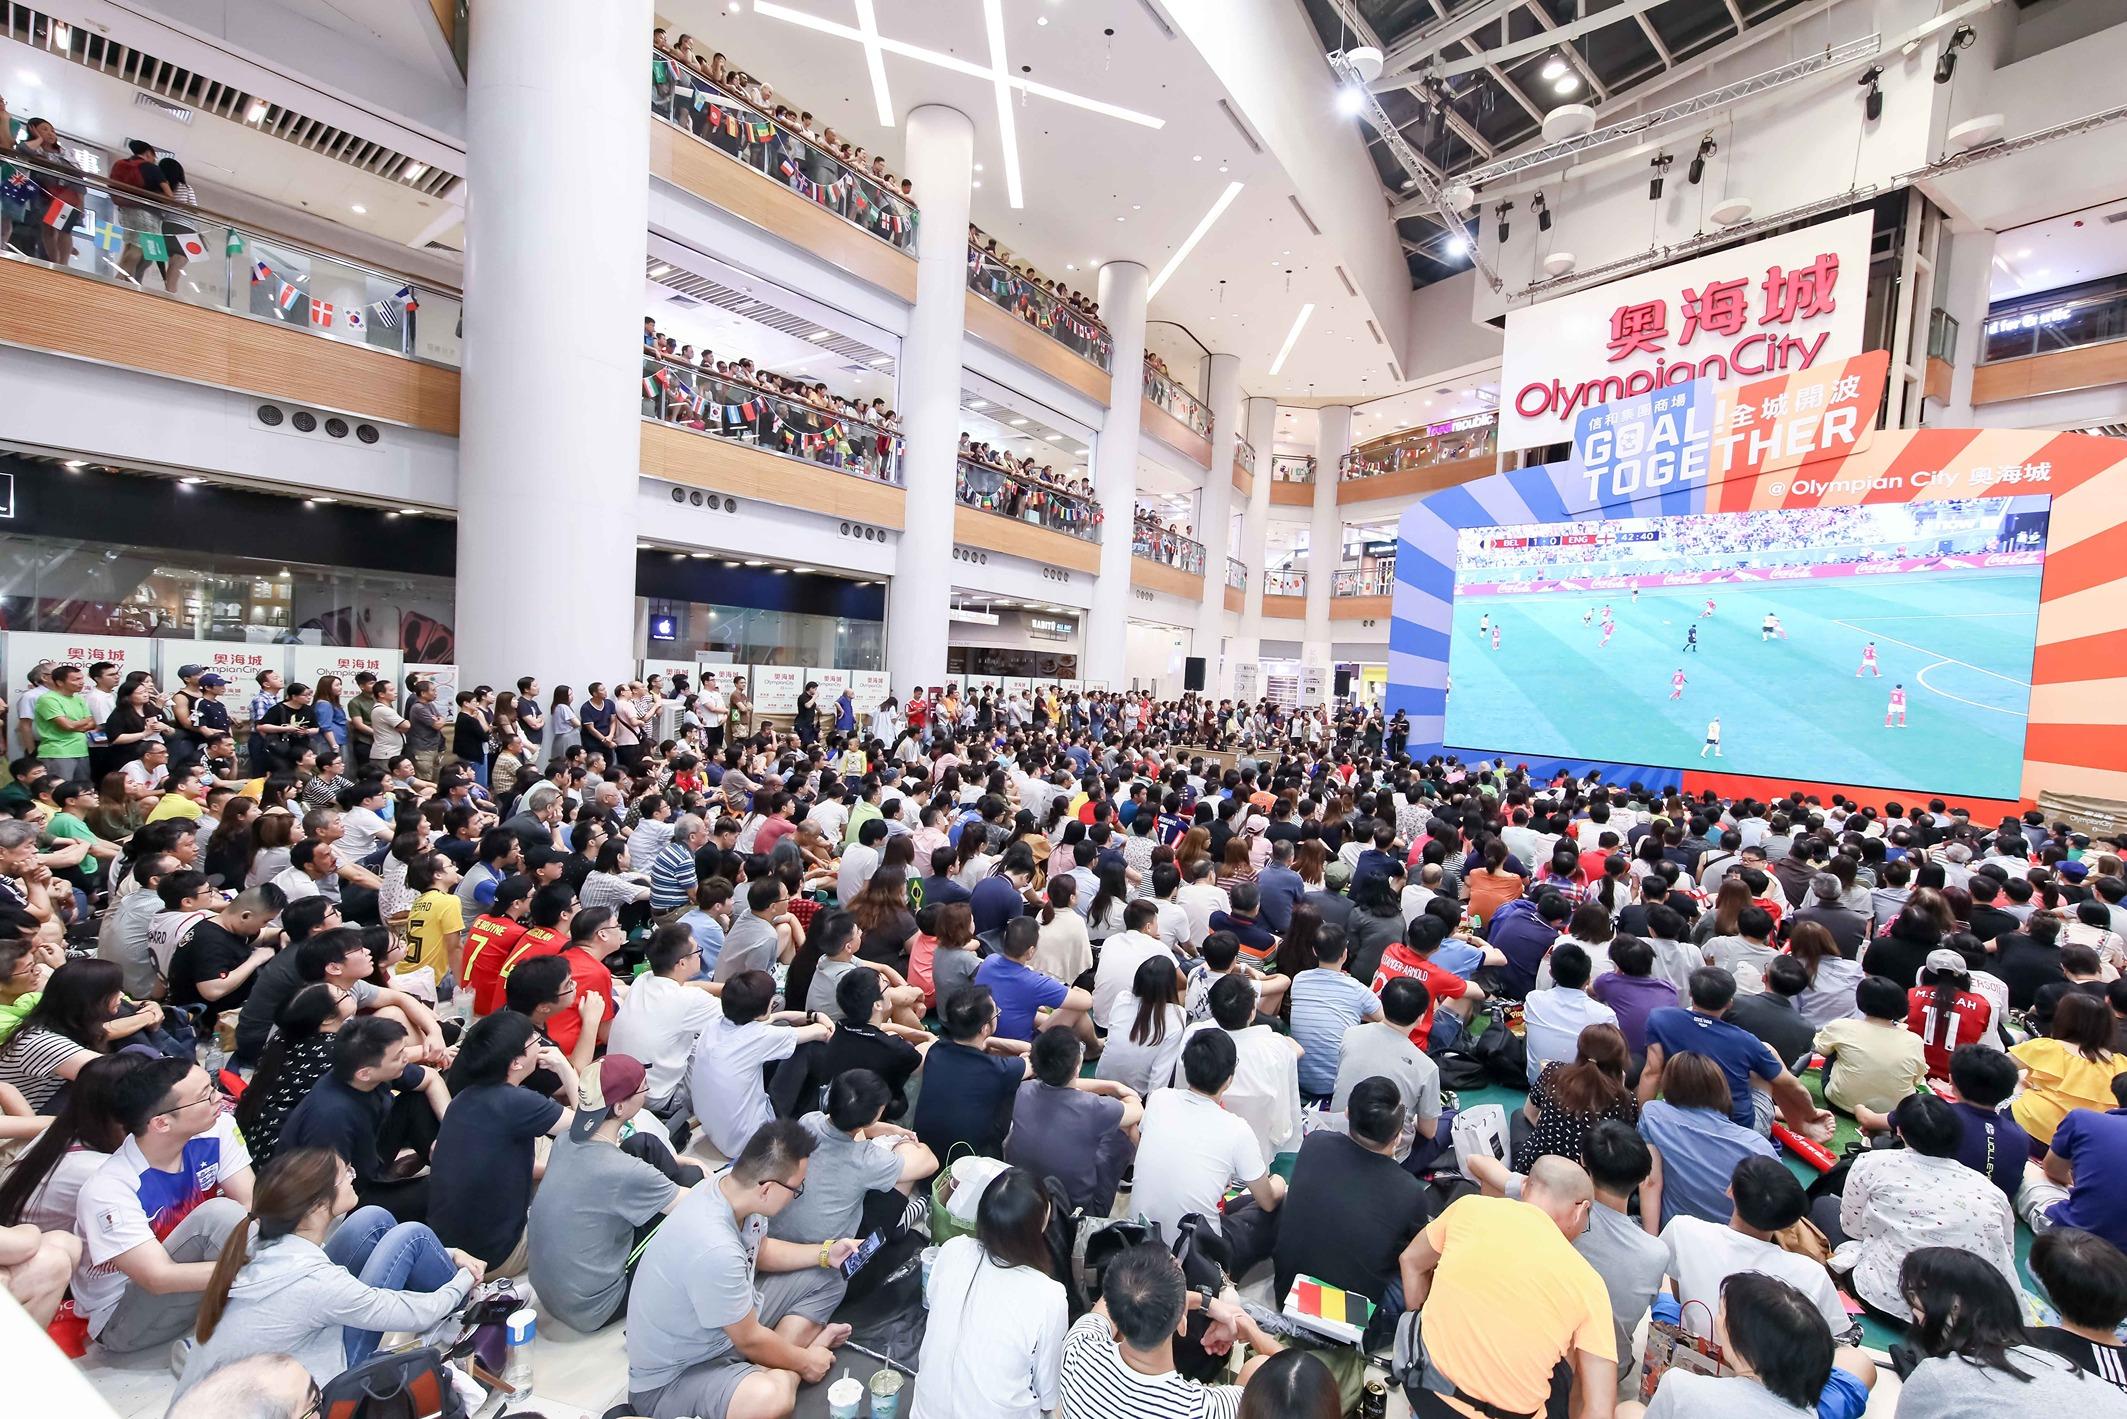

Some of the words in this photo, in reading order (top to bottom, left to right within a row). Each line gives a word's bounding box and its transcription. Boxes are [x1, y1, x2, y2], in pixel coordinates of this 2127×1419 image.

[1607, 253, 1839, 362] 奧海城
[1588, 393, 1686, 431] 信和集團商場
[1728, 374, 1861, 428] 全城開波
[1583, 405, 1858, 502] TOGETHER
[1791, 475, 1902, 497] Olympian
[1910, 469, 1959, 488] City
[1967, 462, 2052, 485] 奧海城
[1503, 538, 1520, 547] BEL
[1568, 535, 1589, 545] ENG
[1620, 532, 1654, 542] 42:40
[67, 647, 125, 661] 奧海城
[214, 653, 262, 665] 奧海城
[337, 658, 379, 669] 奧海城
[464, 934, 489, 981] 7
[1922, 1005, 1961, 1051] 11
